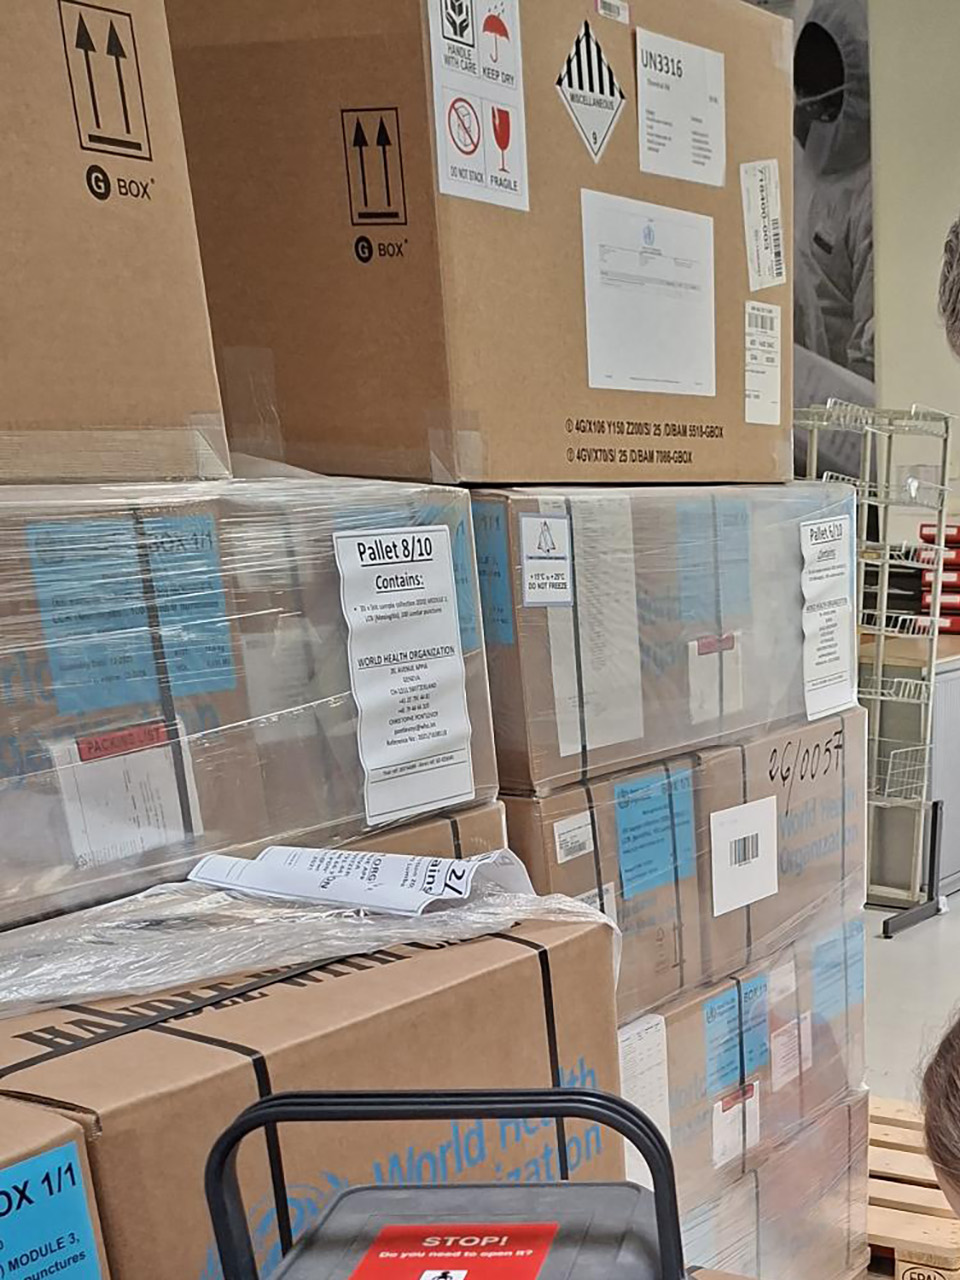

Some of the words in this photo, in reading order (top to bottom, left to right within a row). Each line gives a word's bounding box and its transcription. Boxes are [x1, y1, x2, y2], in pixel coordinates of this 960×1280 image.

[447, 45, 472, 61] HANDLE
[443, 54, 460, 69] WITH
[460, 59, 477, 75] CARE
[641, 49, 683, 78] UN3316
[482, 67, 500, 80] KEEP
[501, 71, 515, 86] DRY
[569, 93, 615, 111] MISCELLANEOUS
[451, 166, 457, 178] DO
[458, 168, 467, 180] NOT
[467, 169, 484, 184] STACK
[490, 175, 518, 192] FRAGILE
[810, 526, 829, 542] Pallet
[357, 539, 400, 562] Pallet
[401, 536, 432, 562] 8/10
[375, 571, 425, 590] Contains:
[528, 582, 536, 590] DO
[537, 582, 548, 590] NOT
[549, 582, 568, 590] FREEZE
[358, 656, 383, 667] WORLD
[384, 652, 408, 663] HEALTH
[409, 646, 455, 661] ORGANIZATION
[41, 1162, 77, 1198] 1/1
[422, 1236, 509, 1247] STOP!
[7, 1235, 66, 1273] MODULE
[68, 1232, 80, 1246] 3,
[401, 1251, 425, 1260] you
[429, 1250, 461, 1258] need
[464, 1250, 477, 1258] to
[480, 1251, 513, 1259] open
[516, 1249, 534, 1257] it?
